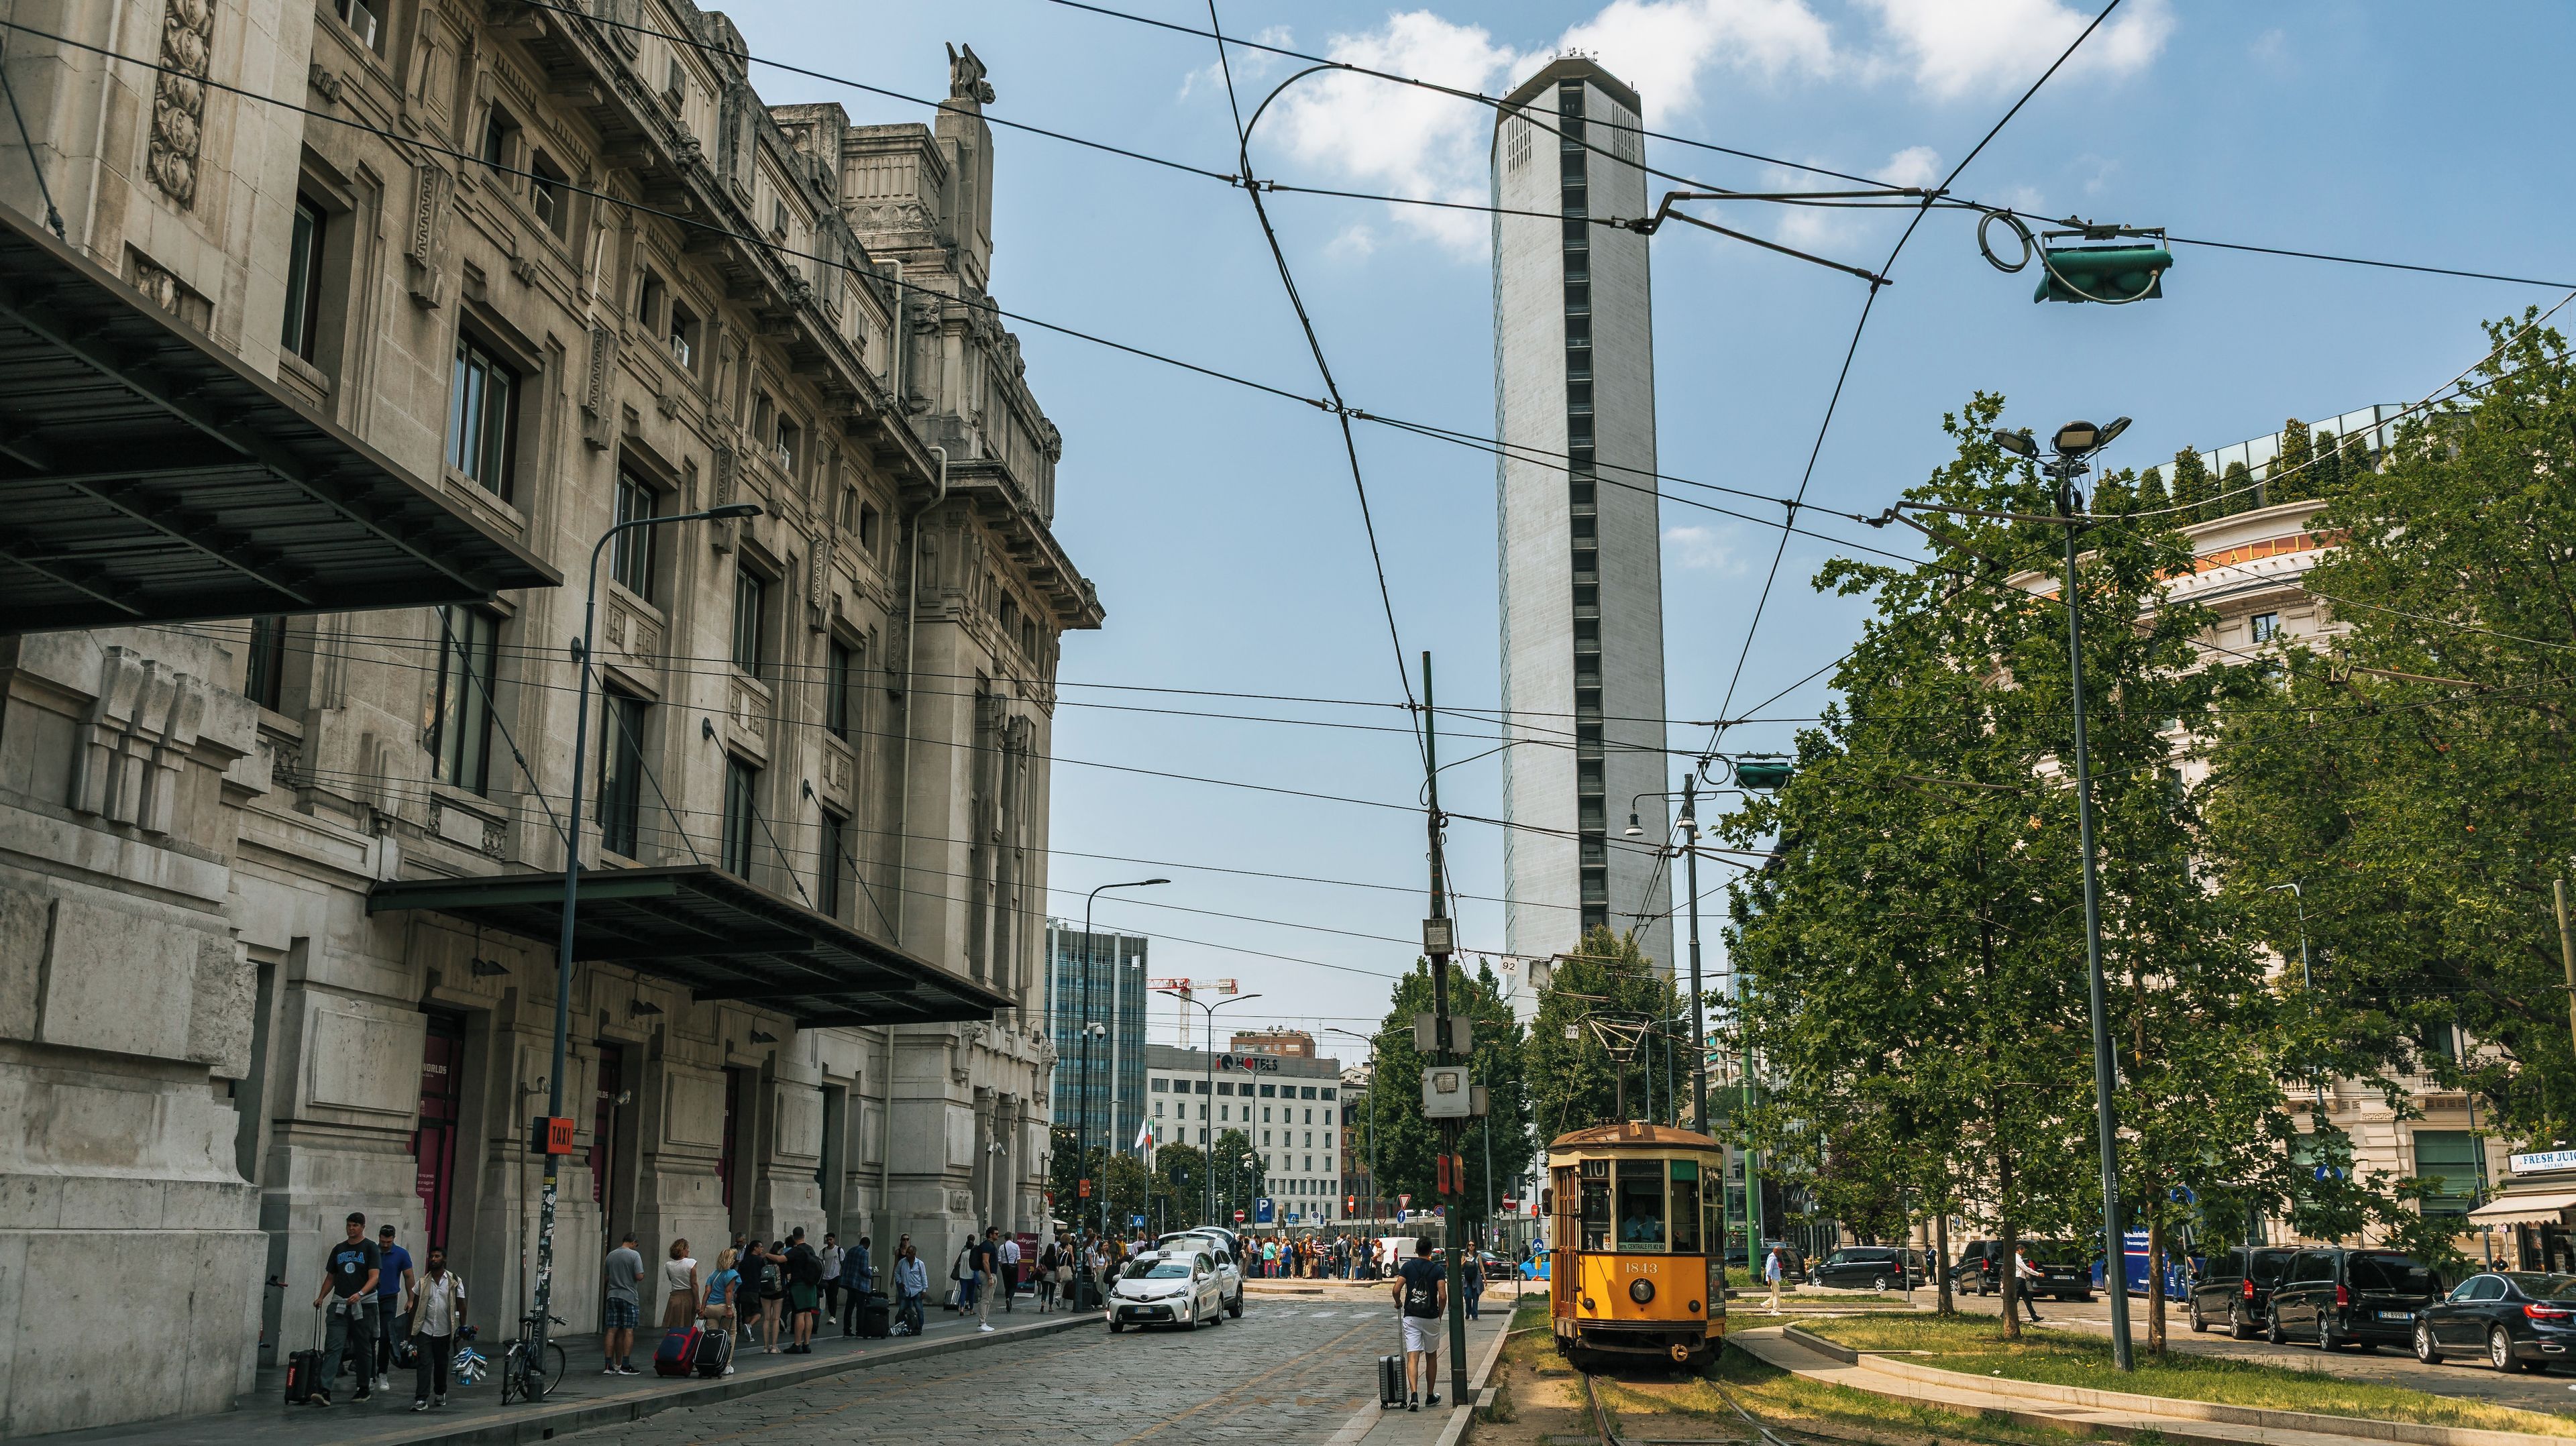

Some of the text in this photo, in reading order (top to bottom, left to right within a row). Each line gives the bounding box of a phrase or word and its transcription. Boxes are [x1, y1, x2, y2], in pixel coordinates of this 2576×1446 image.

[1503, 962, 1515, 971] 92
[1236, 1056, 1278, 1070] HOTELS
[553, 1125, 570, 1146] TAXI
[2523, 1154, 2553, 1164] FRESH
[1588, 1160, 1605, 1176] 10
[1259, 1199, 1269, 1212] P
[337, 1252, 365, 1264] UCLA
[1626, 1262, 1657, 1274] 1843
